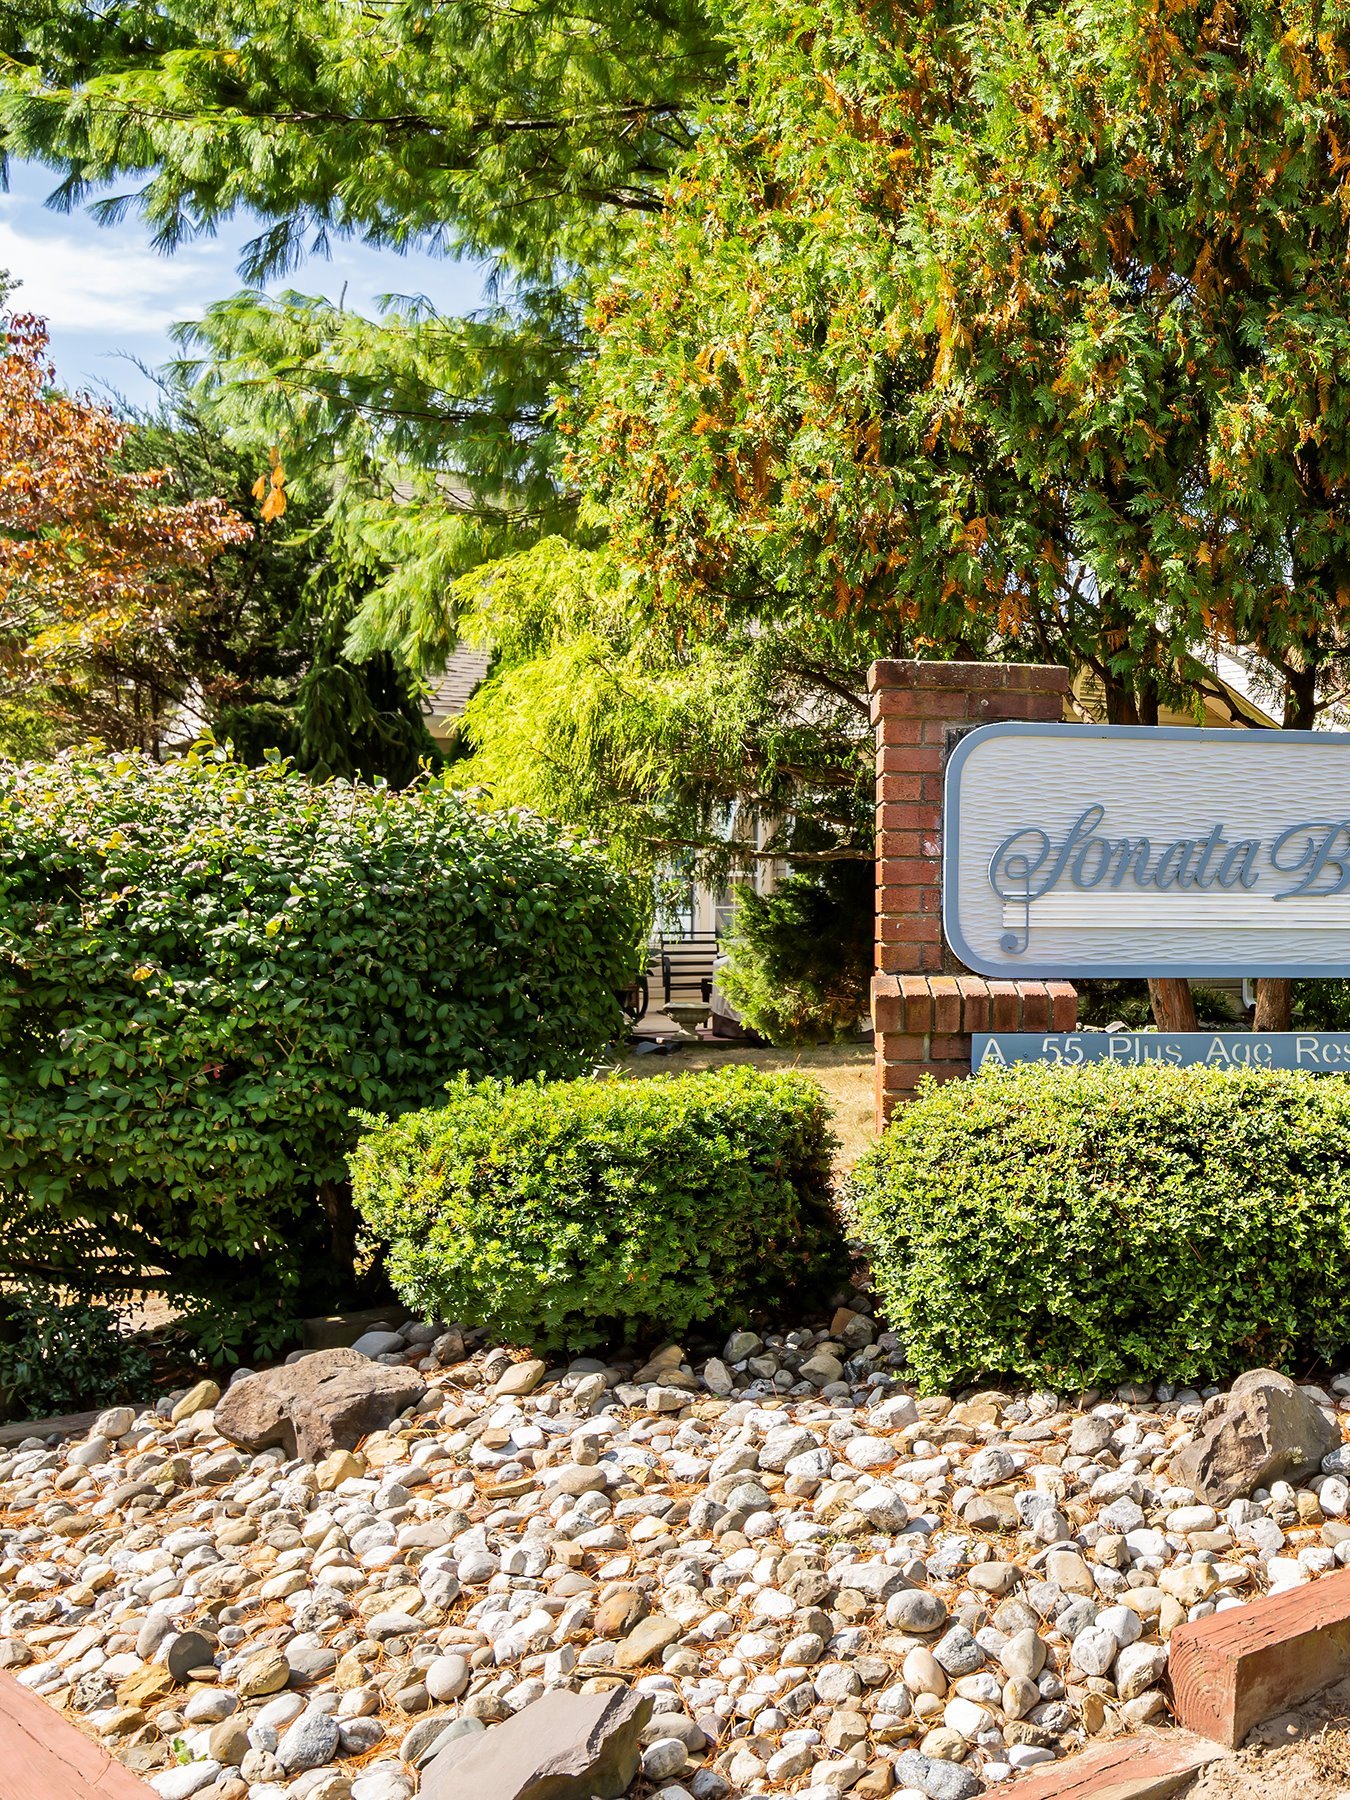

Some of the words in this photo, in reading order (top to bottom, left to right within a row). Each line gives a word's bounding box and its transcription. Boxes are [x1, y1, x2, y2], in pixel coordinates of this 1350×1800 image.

[988, 802, 1261, 954] Sonata
[980, 1037, 1006, 1065] A
[1042, 1038, 1084, 1065] 55
[1109, 1037, 1183, 1065] Plus
[1205, 1036, 1272, 1067] Age
